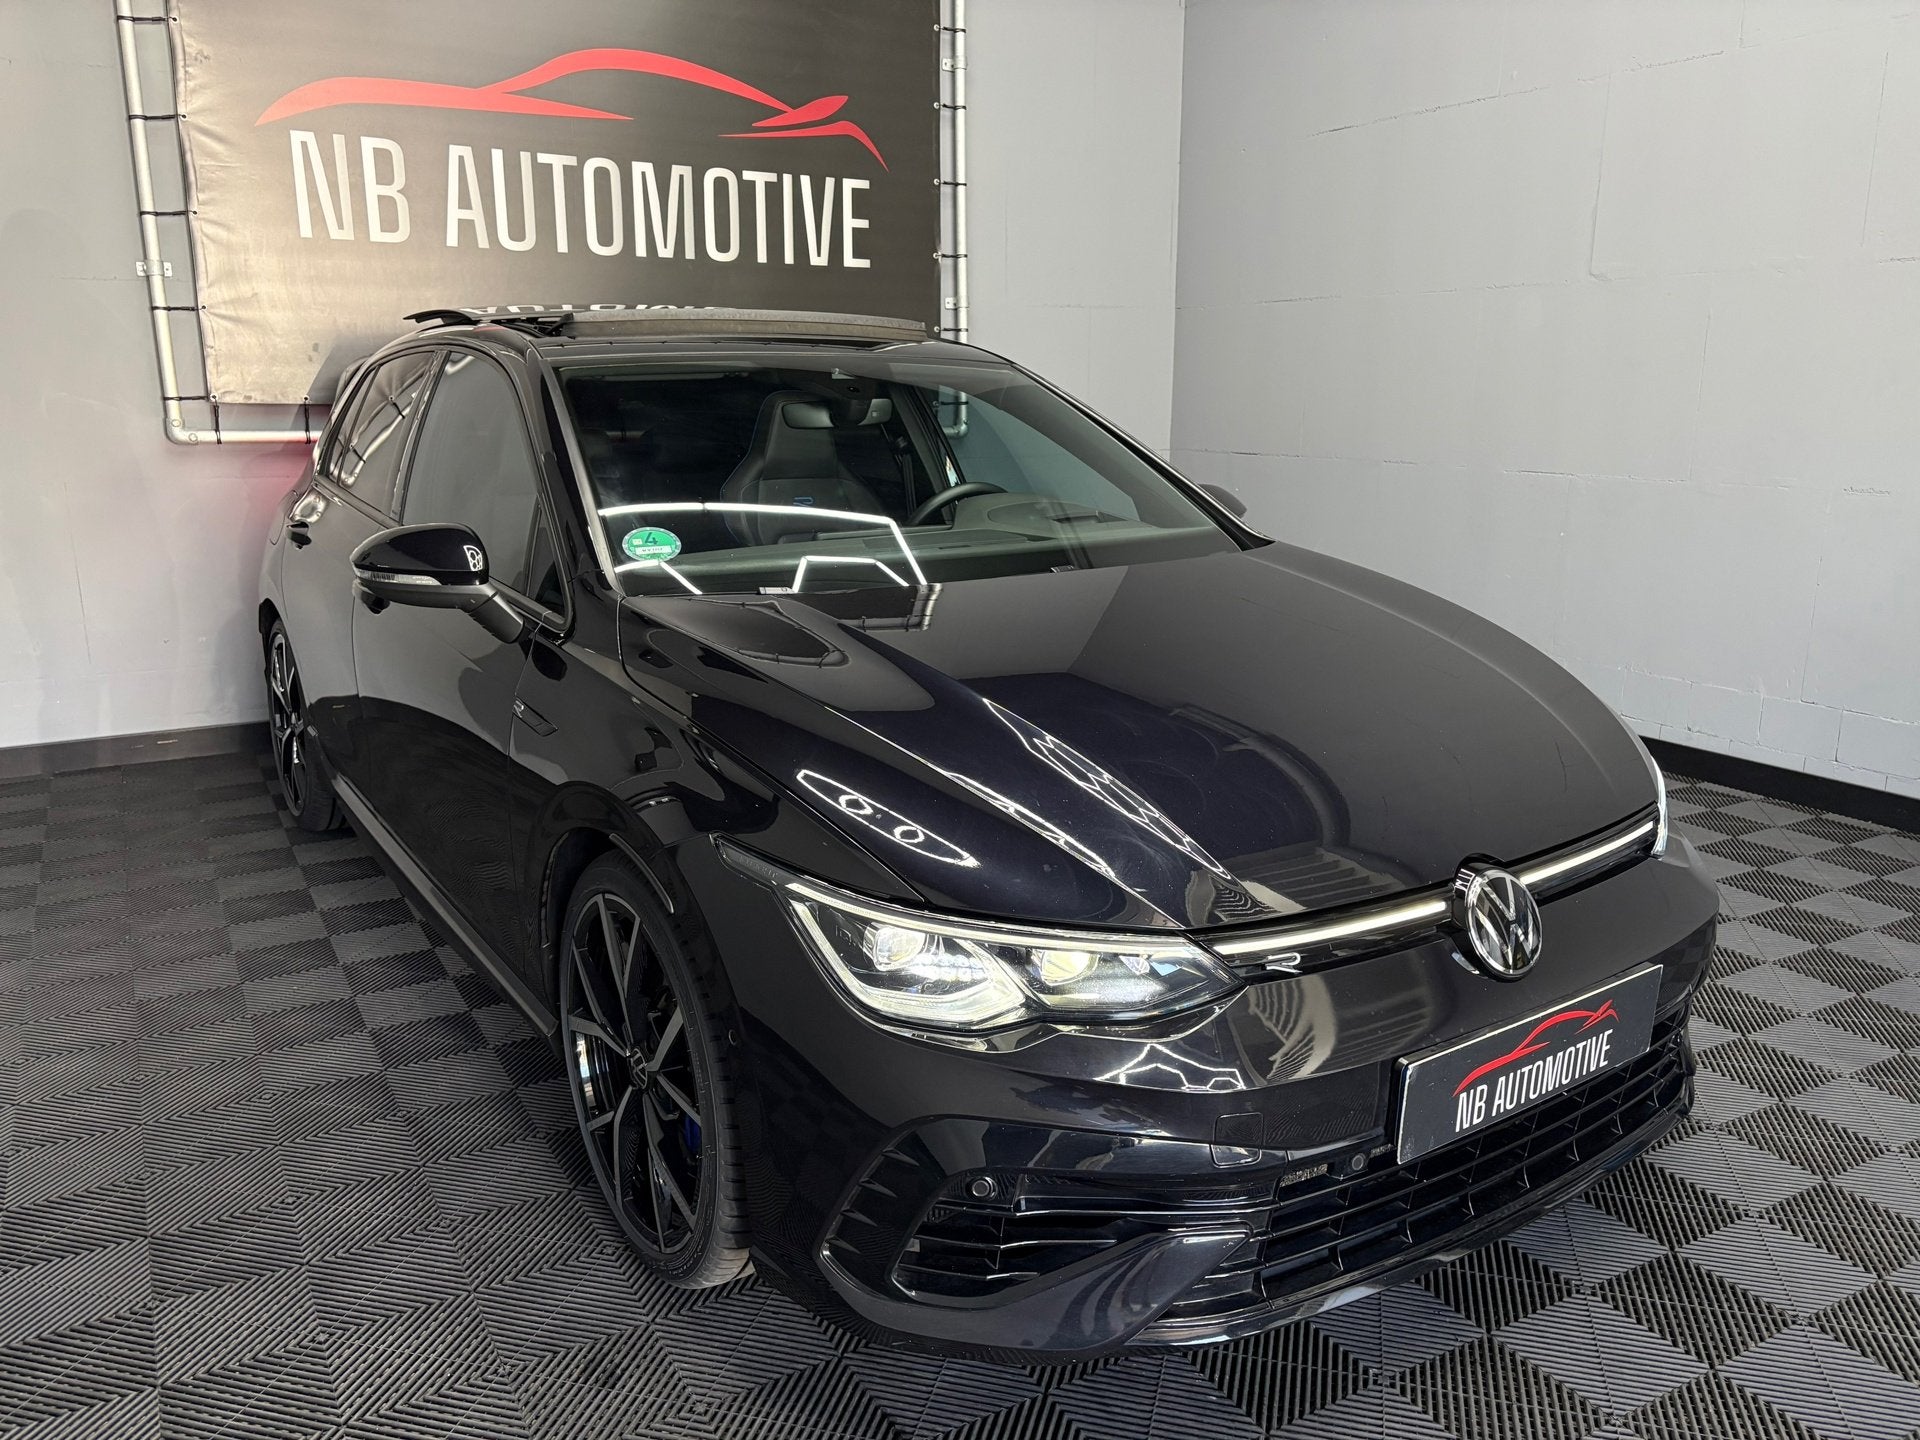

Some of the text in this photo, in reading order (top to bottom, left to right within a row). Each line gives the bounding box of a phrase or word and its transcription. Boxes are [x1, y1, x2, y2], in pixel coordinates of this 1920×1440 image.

[290, 129, 872, 269] NB AUTOMOTIVE
[644, 531, 658, 545] 4
[1265, 951, 1303, 974] R
[1455, 1028, 1614, 1133] NB AUTOMOTIVE
